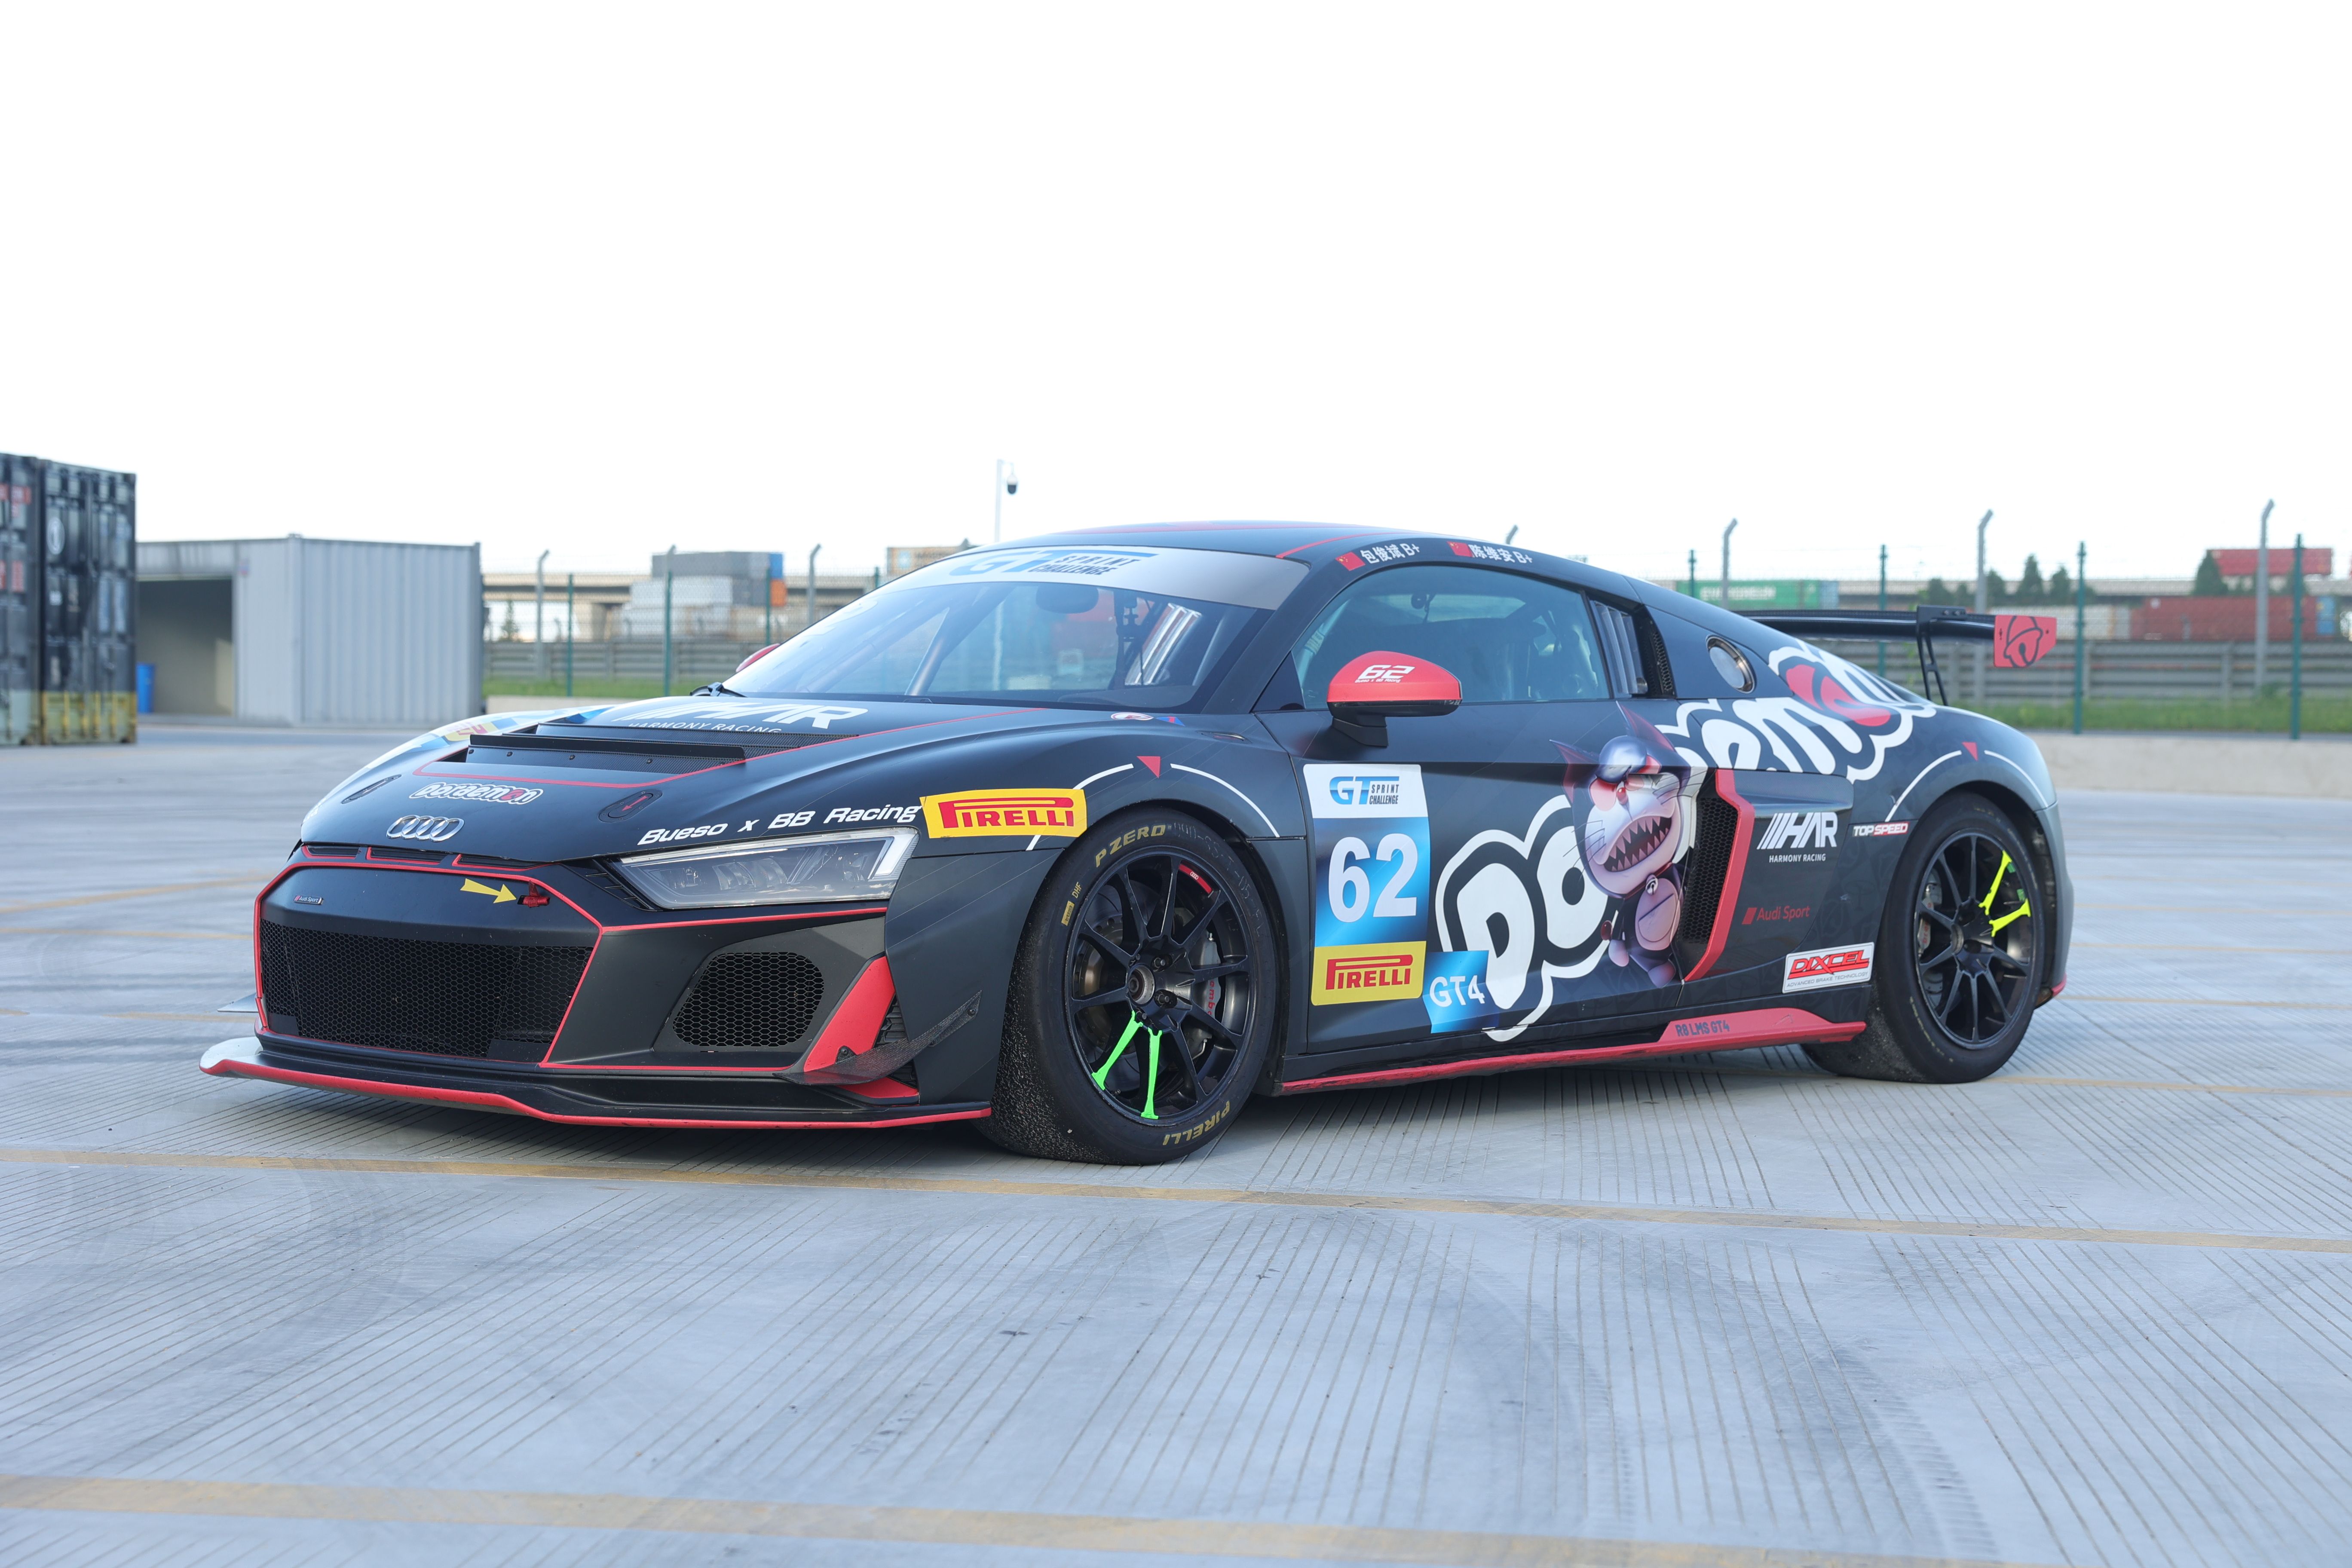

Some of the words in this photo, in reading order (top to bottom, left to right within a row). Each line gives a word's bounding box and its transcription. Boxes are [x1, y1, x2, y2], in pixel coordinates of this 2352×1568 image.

[1400, 543, 1420, 556] B+
[1512, 551, 1533, 563] B+
[949, 550, 1160, 576] GT
[1055, 555, 1141, 566] SPRINT
[1028, 565, 1118, 575] CHALLENGE
[1357, 665, 1415, 680] 62
[1329, 776, 1400, 805] GT
[1371, 784, 1400, 793] SPRINT
[1369, 795, 1399, 805] CHALLENGE
[938, 797, 1074, 828] PIRELLI
[637, 823, 728, 845] Bueso
[737, 819, 760, 832] x
[768, 811, 816, 829] BB
[823, 804, 923, 823] Racing
[1853, 825, 1874, 836] TOP
[1873, 823, 1908, 836] SPEED
[1769, 854, 1801, 863] HARMONY
[1803, 853, 1826, 862] RACING
[1329, 833, 1418, 922] 62
[1072, 882, 1082, 898] DHF
[1757, 906, 1781, 922] Audi
[1783, 906, 1810, 922] Sport
[1788, 949, 1869, 977] DIXCEL
[1326, 955, 1413, 990] PIRELLI
[1834, 972, 1868, 980] TECHNOLOGY
[1430, 975, 1485, 1007] GT4
[1675, 1023, 1689, 1037] R8
[1689, 1022, 1710, 1035] LMS
[1710, 1020, 1730, 1033] GT4
[1162, 1100, 1230, 1145] PIRELLI
